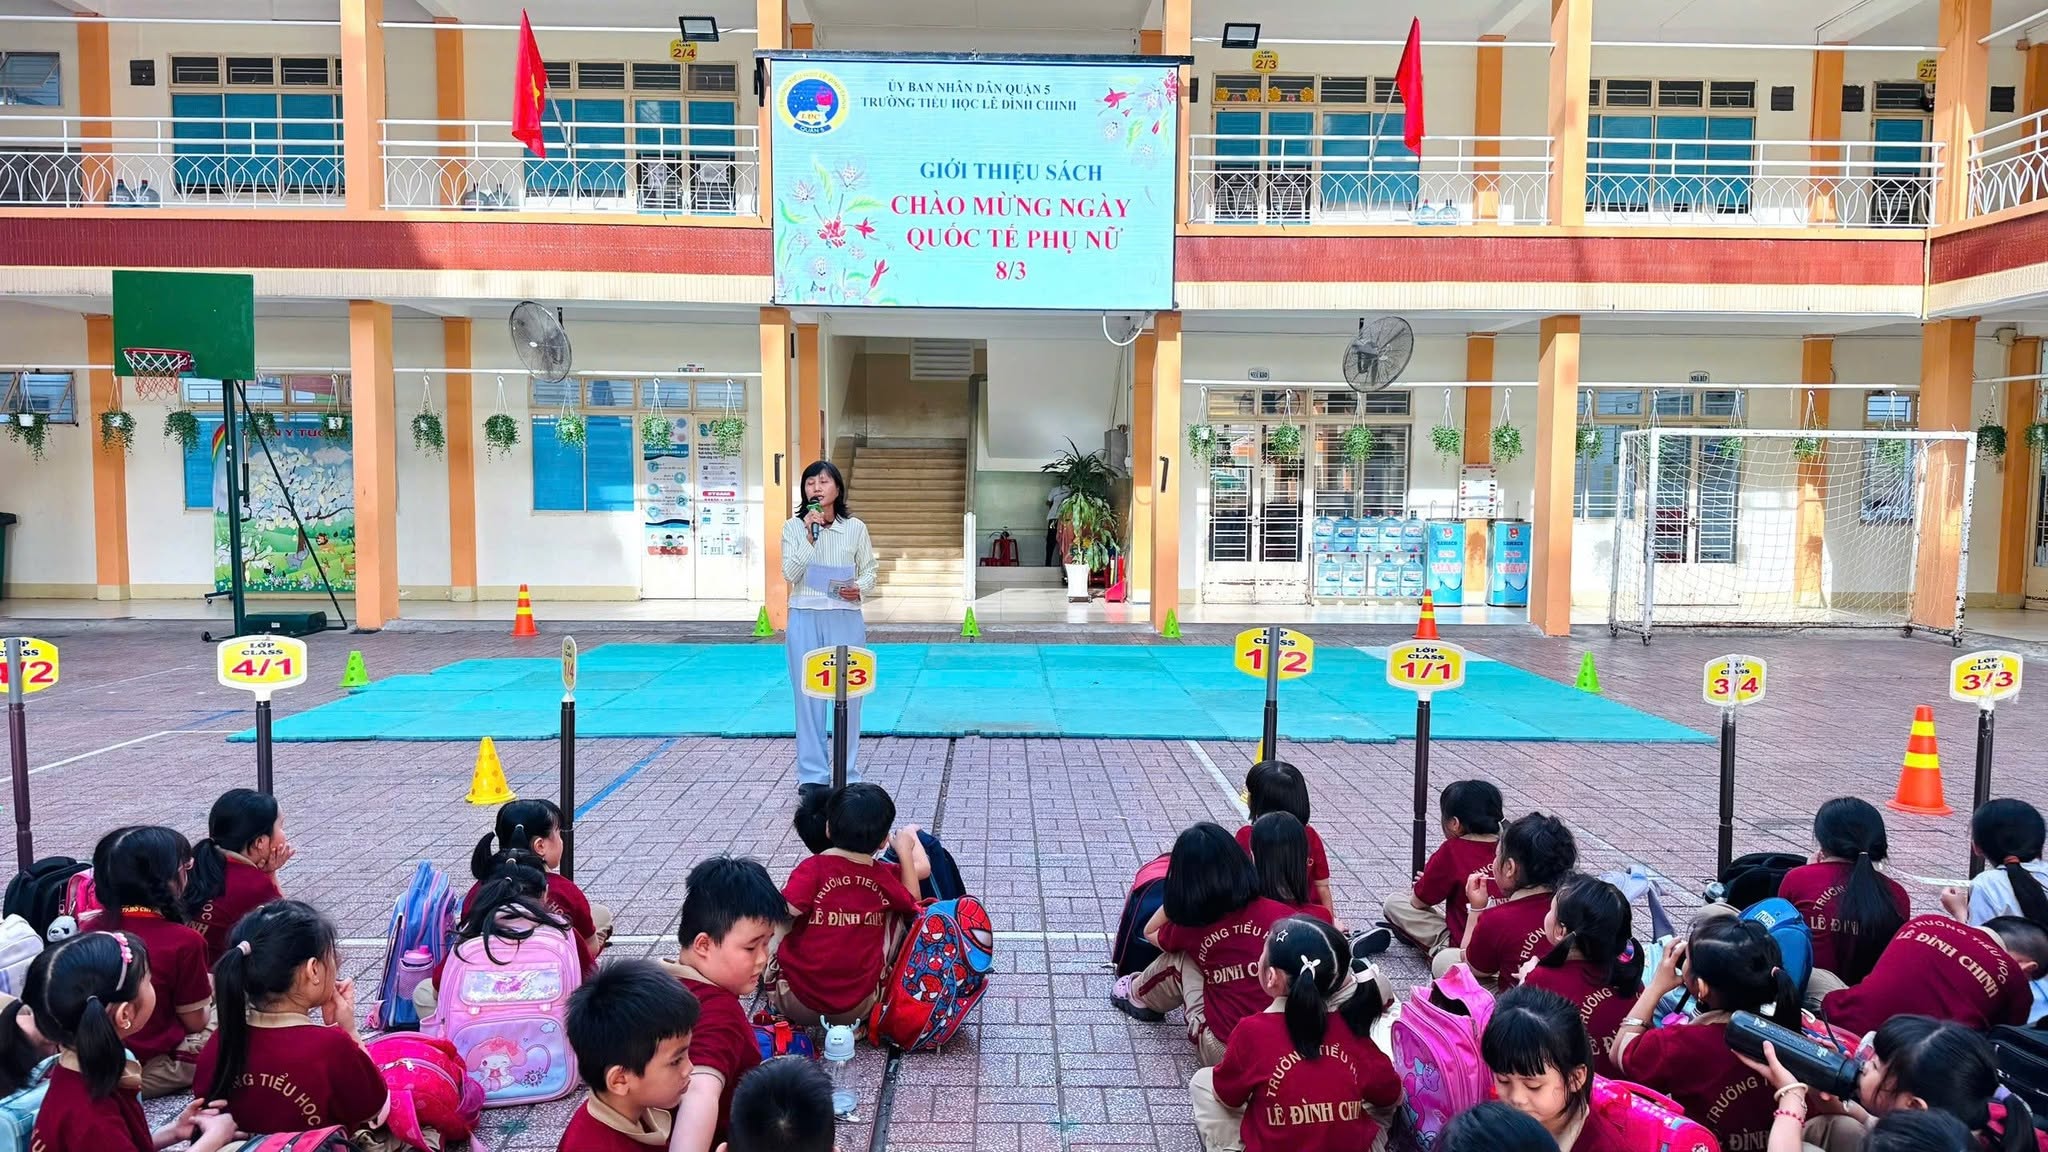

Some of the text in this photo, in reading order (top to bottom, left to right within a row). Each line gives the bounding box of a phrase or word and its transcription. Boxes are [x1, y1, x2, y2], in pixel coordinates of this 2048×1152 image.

[673, 48, 696, 58] 2/4
[1255, 59, 1277, 69] 2/3
[908, 82, 933, 93] BAN
[937, 80, 972, 93] NHÂN
[976, 80, 1001, 94] DÂN
[1044, 84, 1051, 95] 5
[982, 97, 998, 109] LÊ
[920, 158, 1102, 184] GIỚI THIỆU SÁCH
[891, 190, 1131, 218] CHÀO MỪNG NGÀY
[907, 222, 1124, 254] QUỐC TẾ PHỤ NỮ
[996, 260, 1027, 281] 8/3
[1253, 638, 1296, 647] CLSS
[231, 658, 291, 677] 4/1
[1400, 662, 1451, 680] 1/1
[1970, 663, 2004, 671] CLAS
[815, 669, 868, 687] 13
[1962, 671, 2014, 690] 3/3
[828, 908, 861, 927] ĐÌNH
[1810, 914, 1827, 930] LÊ
[1198, 920, 1262, 962] RƯỜNG TIỂU
[1915, 932, 1958, 958] ĐÌNH
[1958, 955, 1999, 998] CHINH
[1580, 987, 1613, 1025] RƯỜNG
[1266, 1050, 1305, 1097] TRƯỜN
[260, 1072, 297, 1097] TIỂU
[294, 1092, 321, 1126] HỌC
[1266, 1102, 1286, 1126] LÊ
[1290, 1098, 1335, 1125] ĐÌNH
